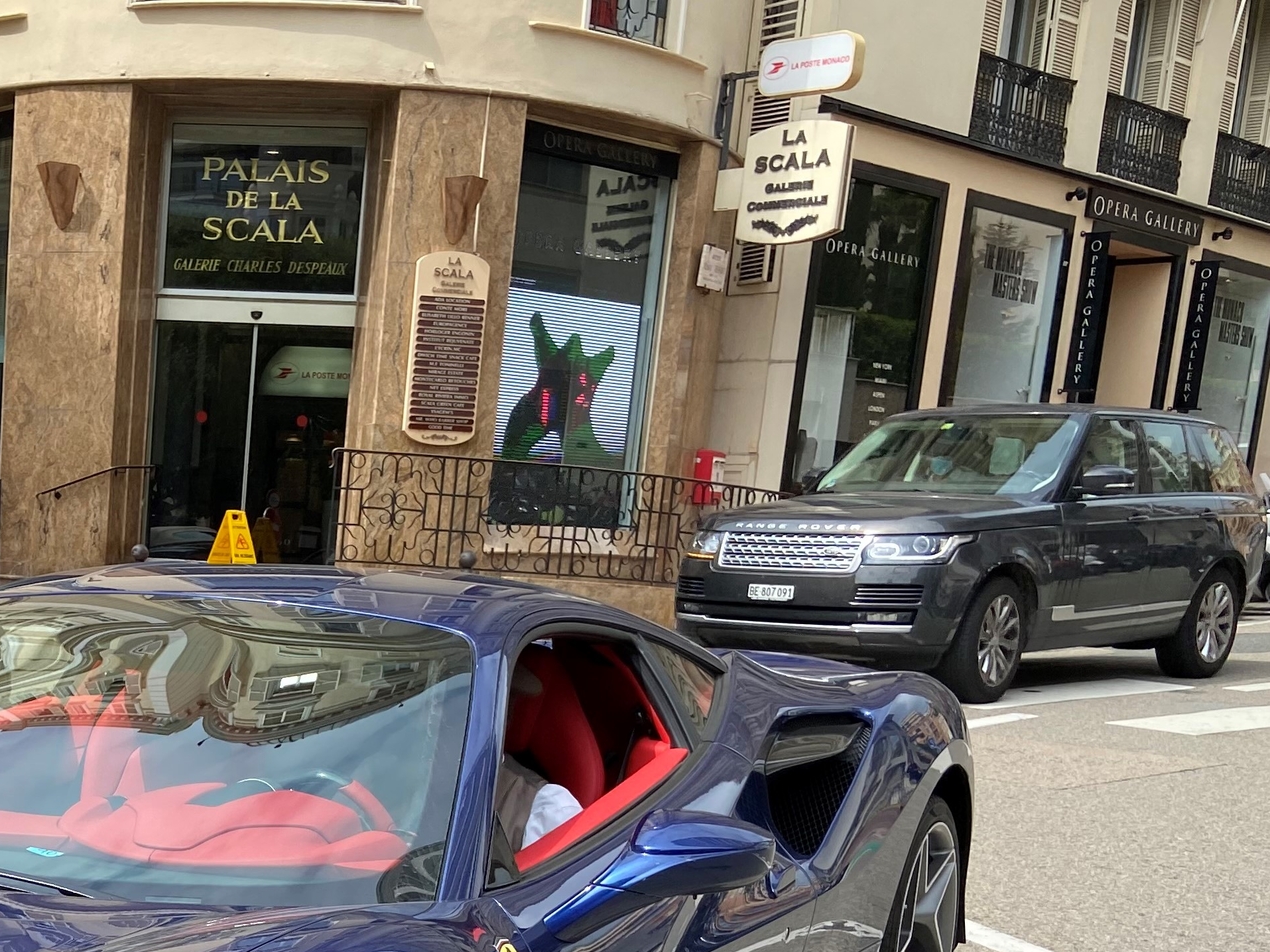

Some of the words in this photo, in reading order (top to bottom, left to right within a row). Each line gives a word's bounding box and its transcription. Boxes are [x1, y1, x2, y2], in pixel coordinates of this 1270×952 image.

[791, 61, 799, 70] LA
[800, 59, 821, 69] POSTE
[822, 55, 850, 67] MONACO
[544, 131, 592, 155] OPERA
[596, 143, 658, 169] GALLERY
[782, 130, 807, 146] LA
[202, 157, 330, 184] PALAIS
[754, 149, 831, 174] SCALA
[765, 180, 814, 194] GALERIE
[226, 190, 259, 209] DE
[269, 191, 303, 210] LA
[747, 195, 828, 213] COMMERCIALE
[1093, 195, 1138, 222] OPERA
[1144, 209, 1200, 238] GALLERY
[202, 217, 324, 244] SCALA
[448, 257, 462, 266] LA
[826, 238, 865, 257] OPERA
[871, 247, 921, 268] GALLERY
[173, 258, 221, 272] GALERIE
[227, 260, 282, 274] CHARLES
[287, 261, 348, 275] DESPEAUX
[434, 267, 474, 280] SCALA
[1085, 239, 1102, 299] OPERA
[992, 272, 1021, 301] MASTERS
[1194, 268, 1212, 323] OPERA
[1073, 305, 1092, 385] GALLERY
[1183, 329, 1200, 403] GALLERY
[798, 523, 862, 531] ROVER
[750, 586, 759, 596] BE
